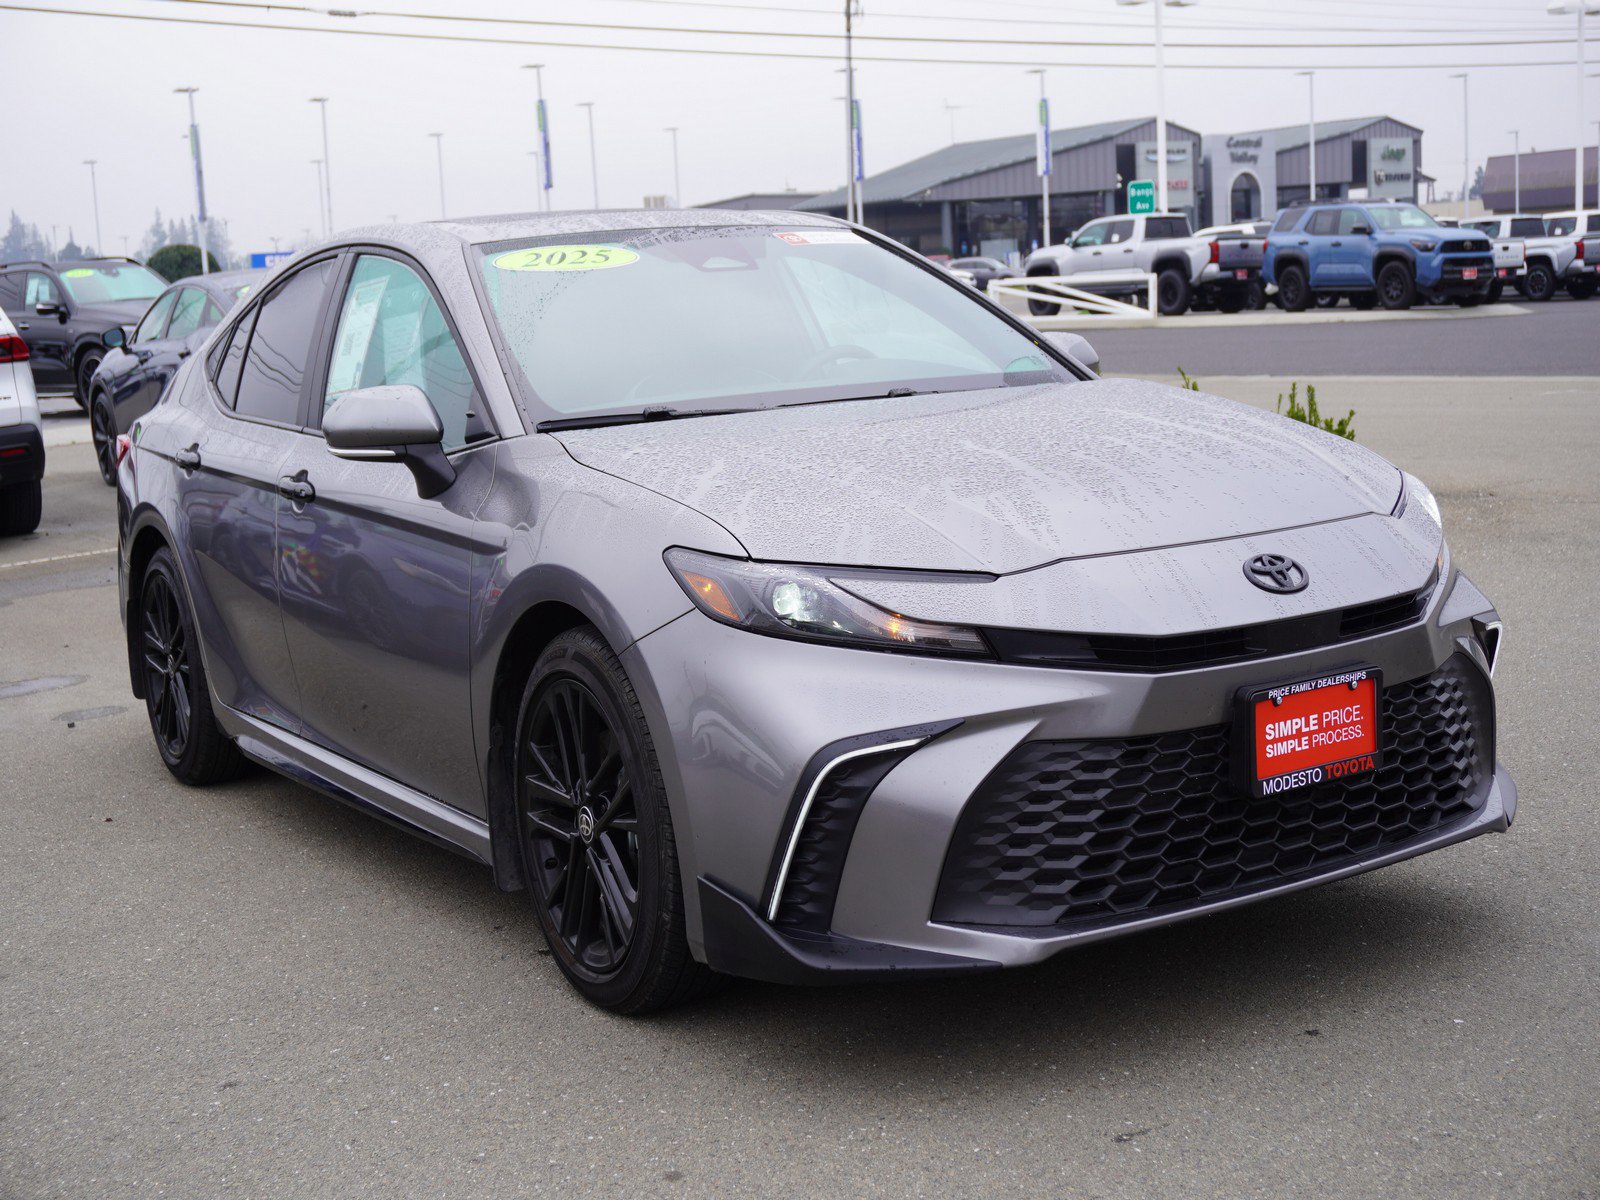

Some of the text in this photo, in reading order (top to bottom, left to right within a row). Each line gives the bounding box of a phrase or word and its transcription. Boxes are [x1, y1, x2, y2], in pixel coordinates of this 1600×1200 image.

[522, 249, 612, 267] 2025
[1268, 671, 1367, 699] PRICE FAMILY DEALERSHIPS
[1265, 704, 1364, 740] SIMPLE PRICE.
[1265, 724, 1365, 758] SIMPLE PROCESS.
[1263, 756, 1375, 796] MODESTO TOYOTA
